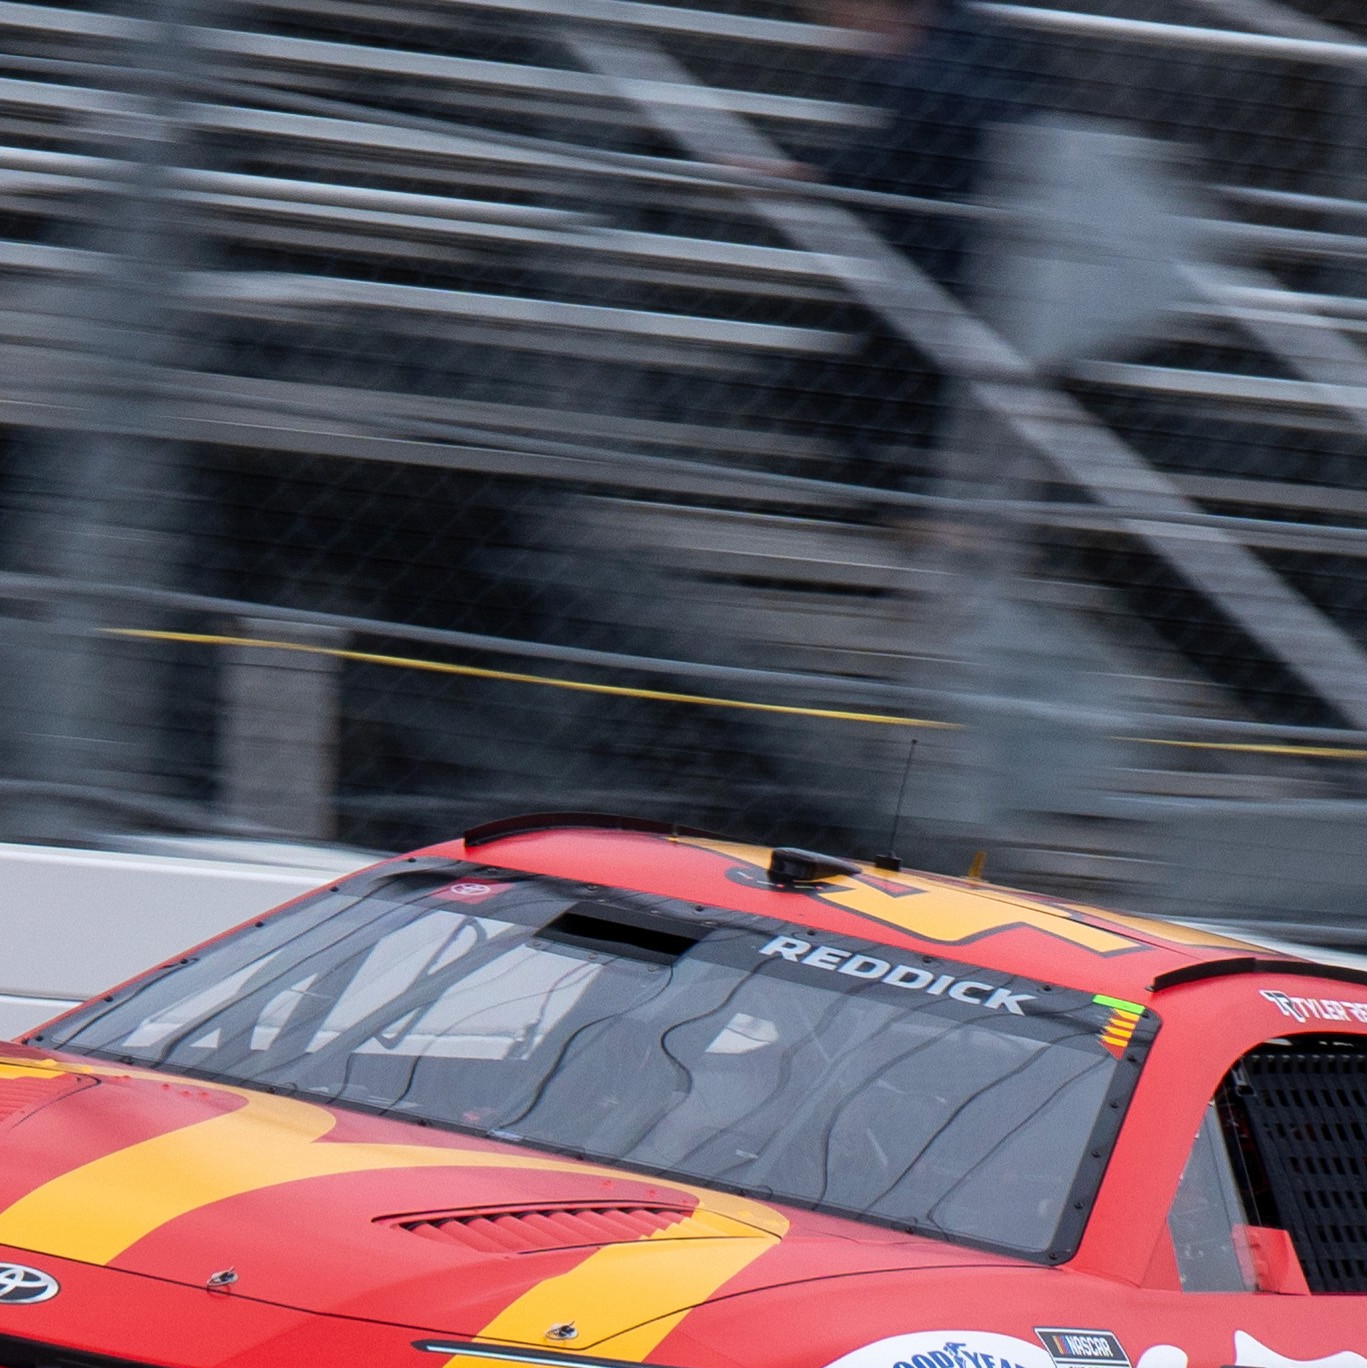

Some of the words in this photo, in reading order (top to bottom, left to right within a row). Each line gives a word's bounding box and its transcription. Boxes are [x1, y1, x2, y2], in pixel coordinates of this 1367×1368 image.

[759, 935, 1037, 1016] REDDICK
[1289, 997, 1352, 1022] TYLER
[1067, 1335, 1114, 1358] NASCAR
